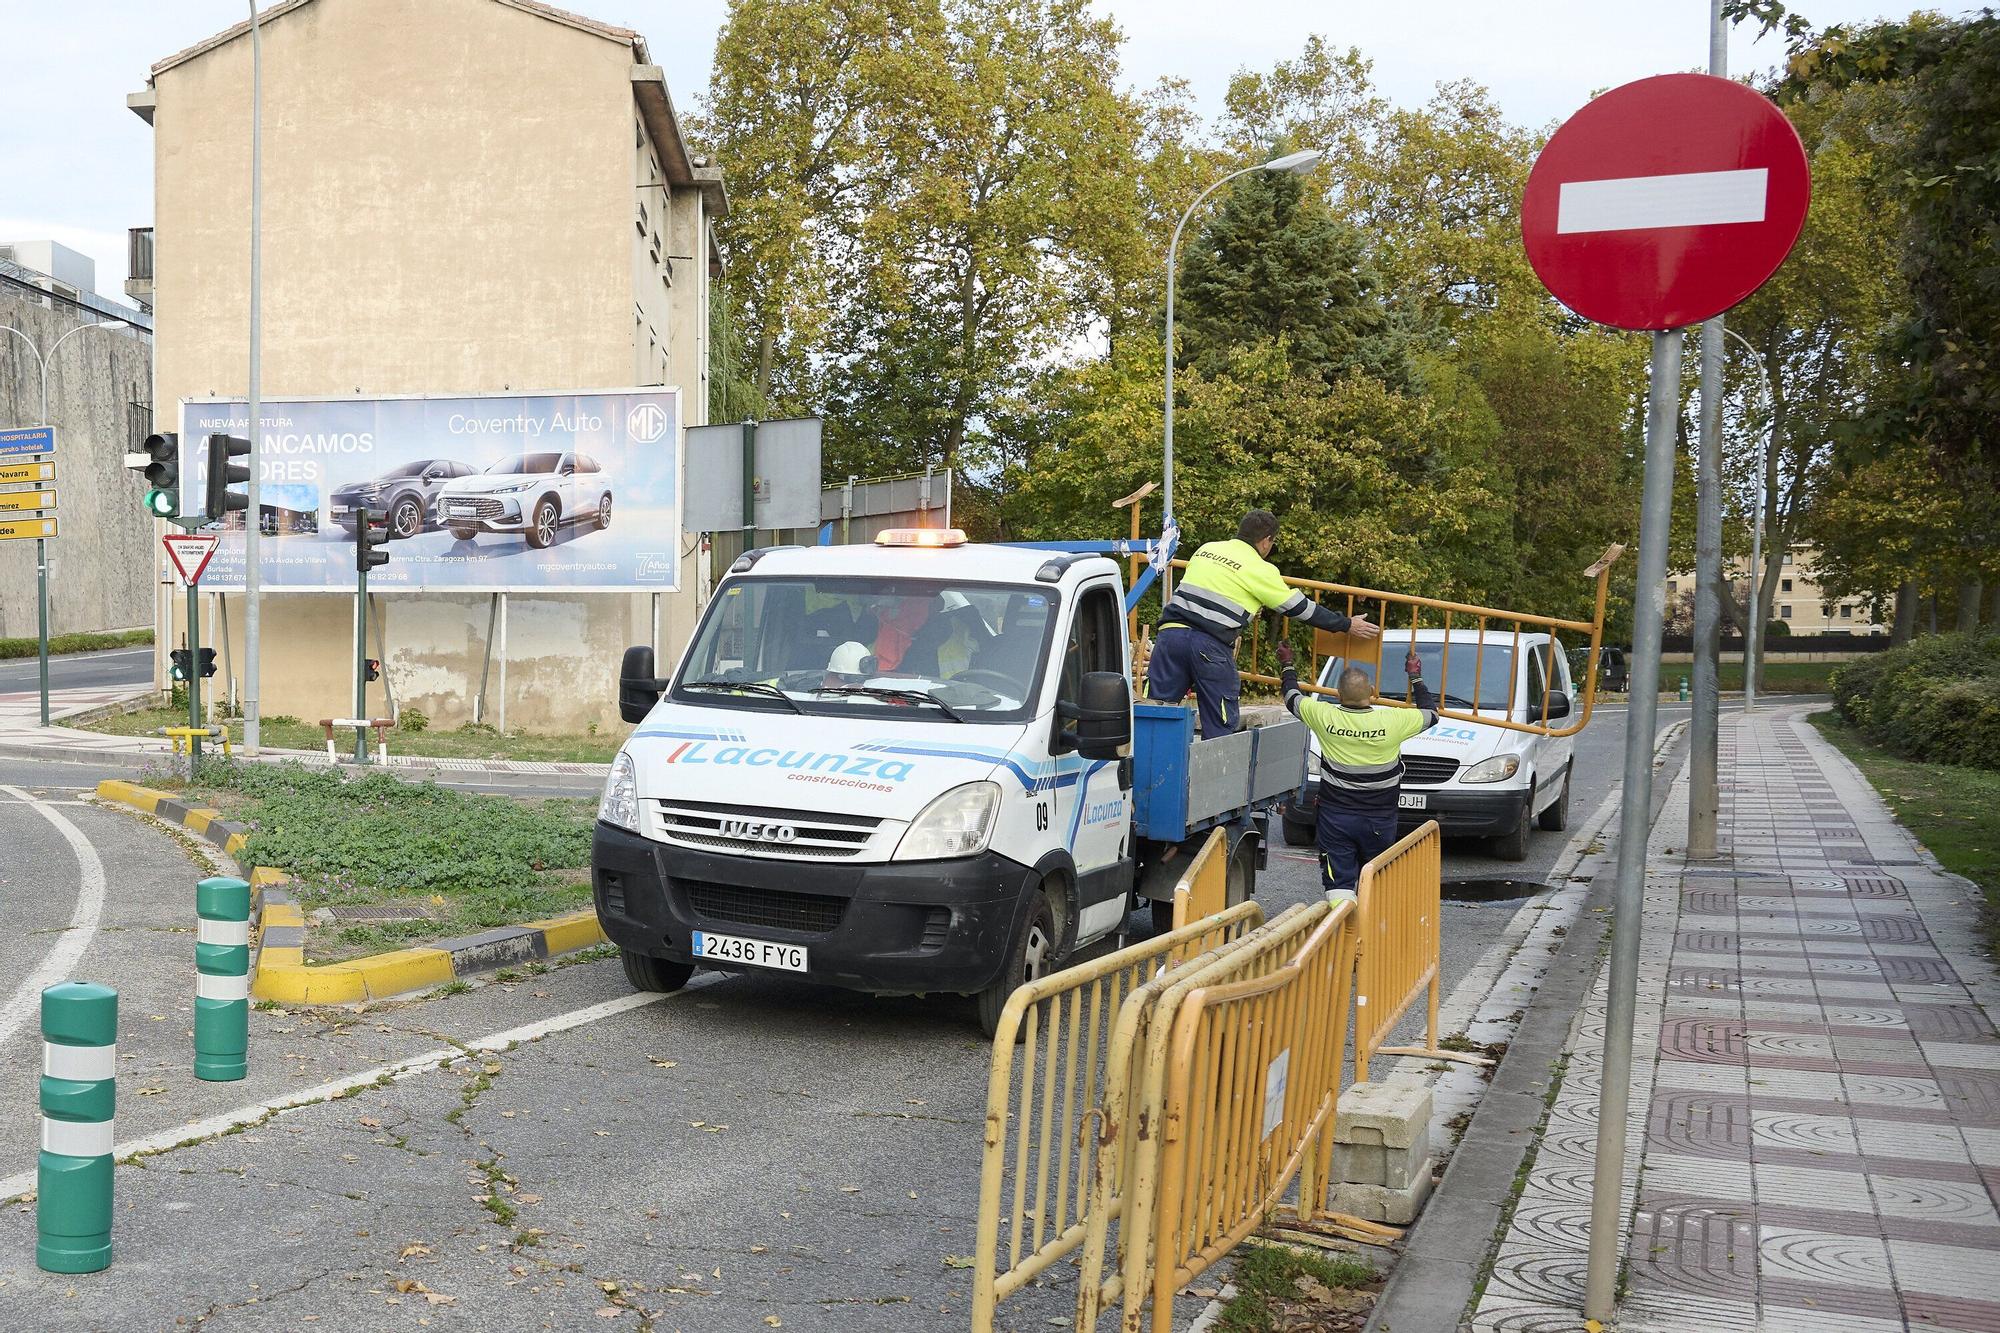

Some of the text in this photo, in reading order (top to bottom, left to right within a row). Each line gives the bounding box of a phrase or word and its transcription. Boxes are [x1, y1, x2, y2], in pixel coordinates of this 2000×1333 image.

[200, 417, 293, 428] NUEVA APRTURA
[448, 412, 602, 436] Coventry Auto
[632, 408, 664, 438] MG
[537, 560, 617, 572] mgcoventryauto.es
[787, 772, 894, 793] construcciones
[1036, 802, 1048, 831] 09
[718, 819, 797, 842] IVECO
[707, 937, 755, 960] 2436
[763, 945, 801, 967] FYG
